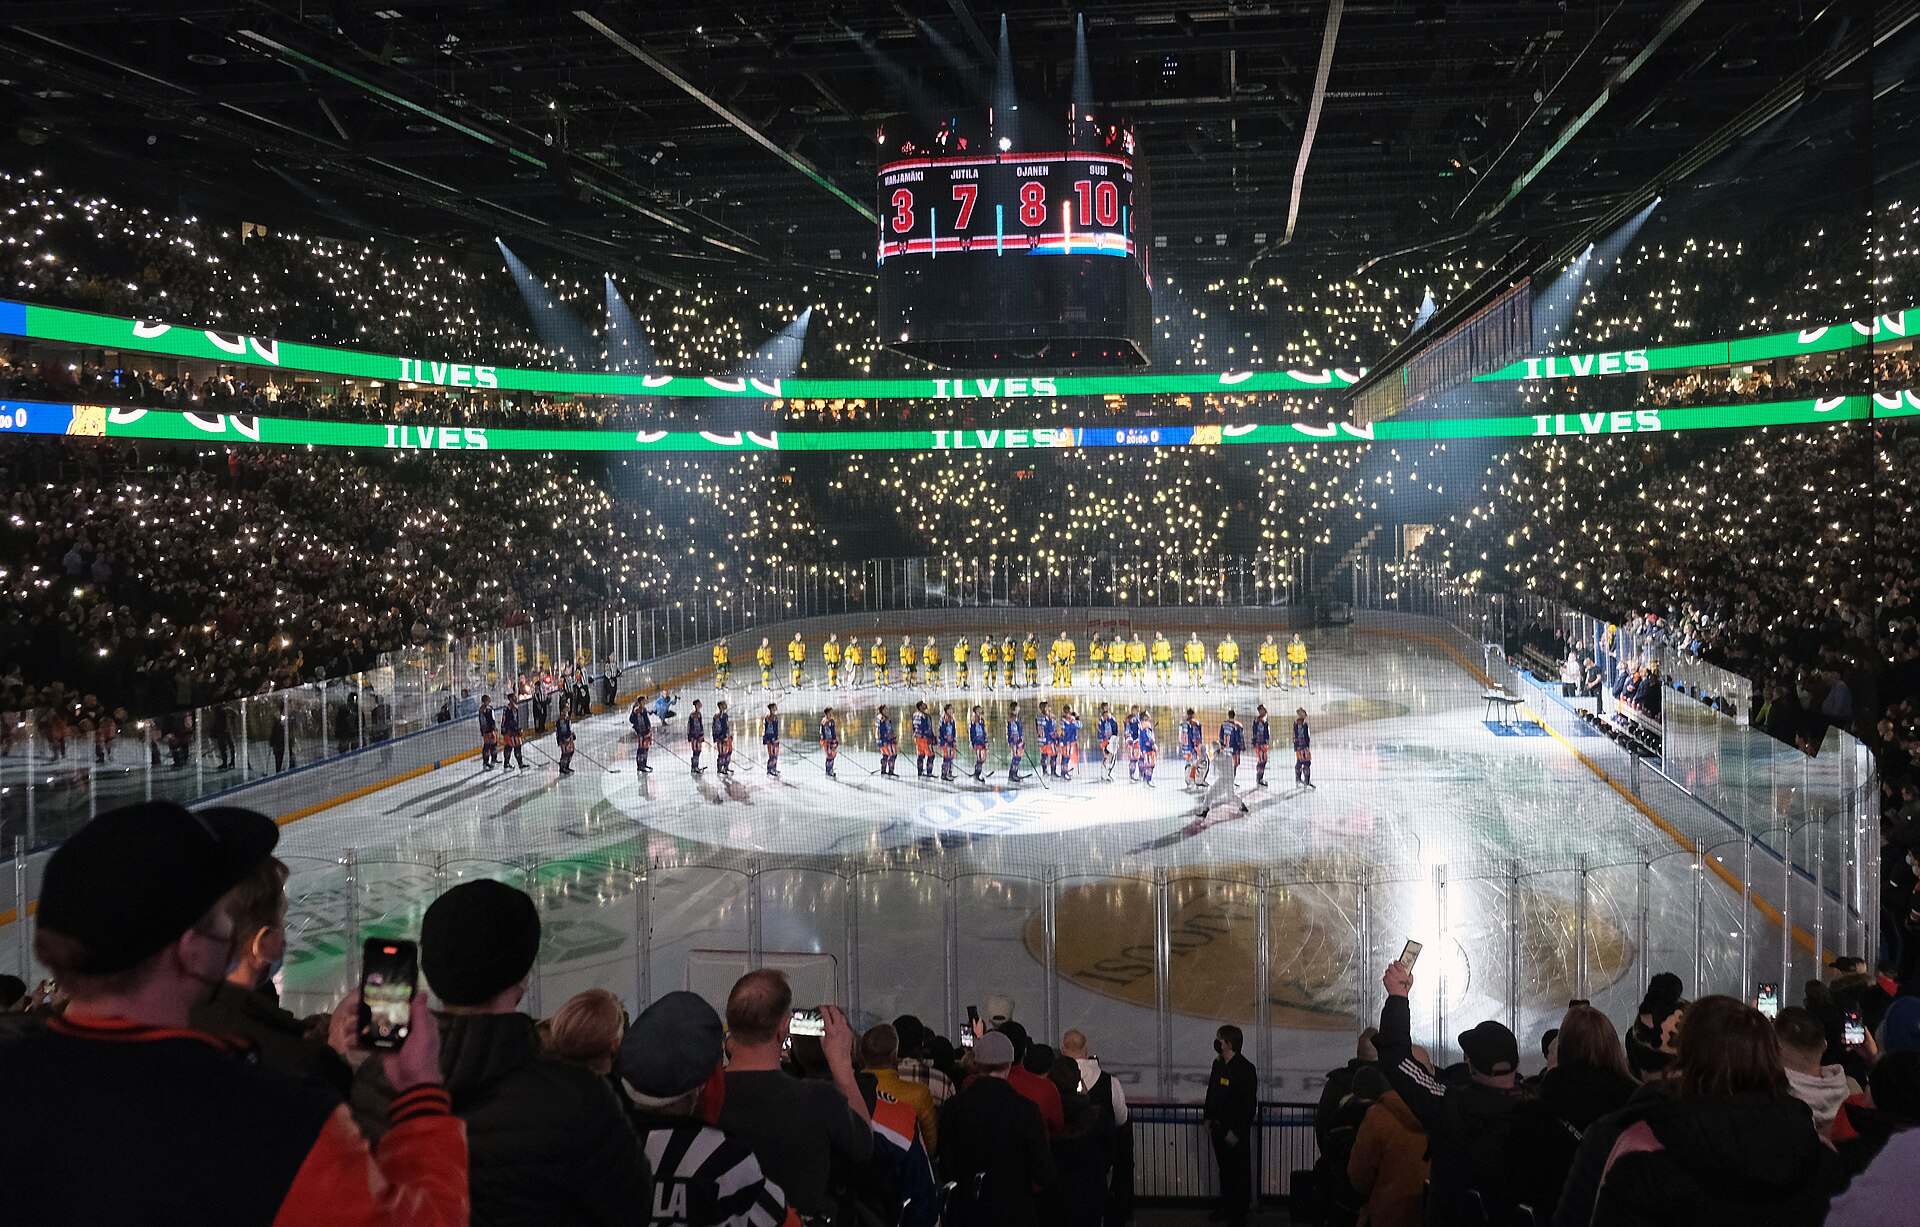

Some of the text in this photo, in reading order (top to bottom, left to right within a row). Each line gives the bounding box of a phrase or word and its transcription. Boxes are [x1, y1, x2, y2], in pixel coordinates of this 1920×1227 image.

[951, 168, 979, 179] JUTILA
[1016, 165, 1049, 177] OJANEN
[1089, 164, 1108, 176] SUSI
[892, 188, 914, 233] 3
[952, 184, 978, 230] 7
[1020, 181, 1047, 227] 8
[1074, 180, 1118, 227] 10
[398, 357, 498, 389] ILVES
[1523, 350, 1649, 379] ILVES
[932, 377, 1057, 399] ILVES
[15, 408, 27, 428] 0
[1532, 409, 1662, 436] ILVES
[384, 424, 488, 450] ILVES
[931, 428, 1058, 449] ILVES
[1116, 430, 1159, 444] 0 20:00 0
[652, 1182, 687, 1218] LA
